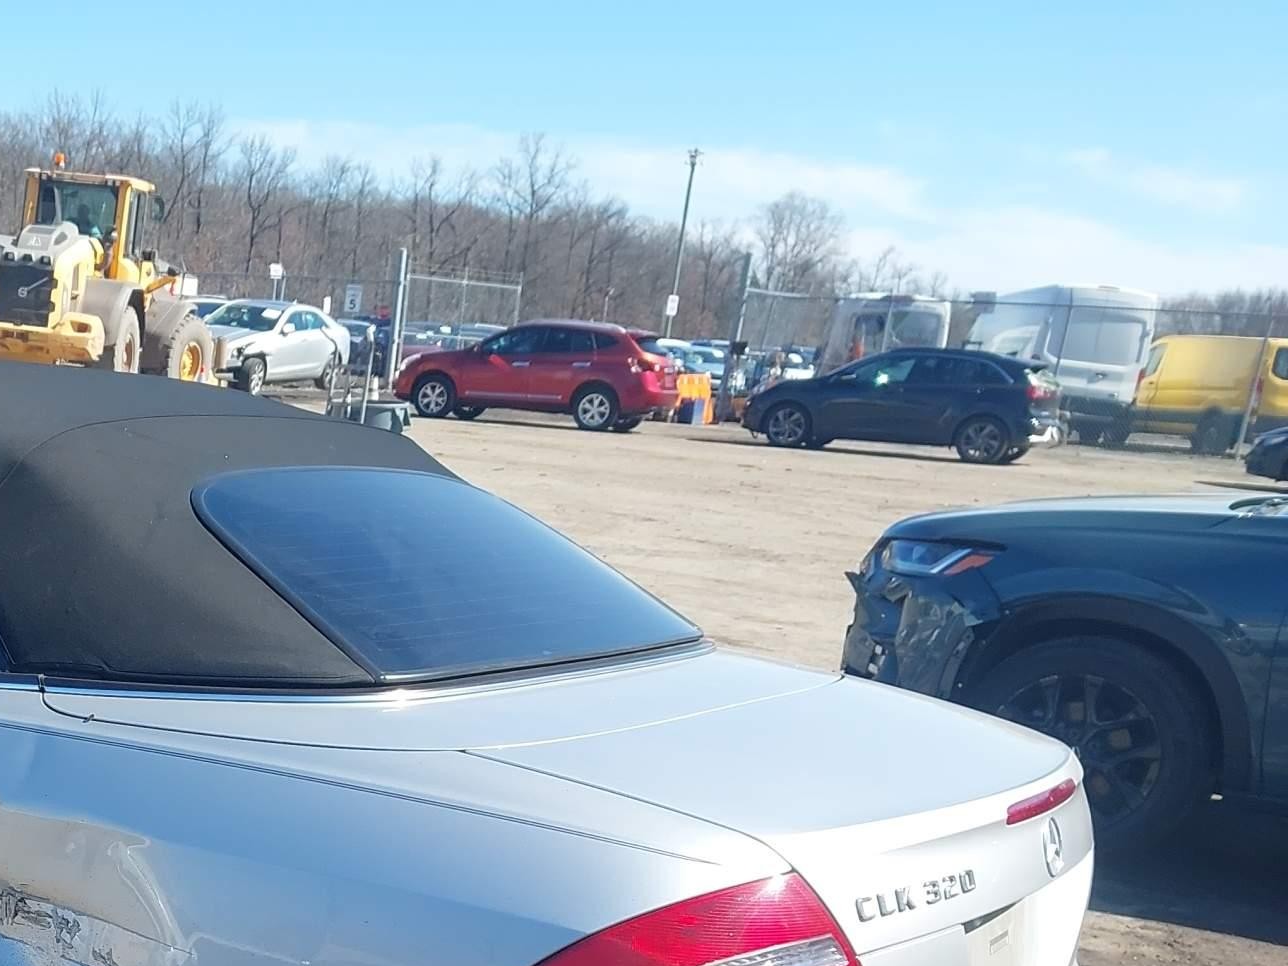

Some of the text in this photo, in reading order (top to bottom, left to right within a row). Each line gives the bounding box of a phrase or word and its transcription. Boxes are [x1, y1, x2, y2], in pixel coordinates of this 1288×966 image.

[348, 298, 357, 310] 5
[855, 869, 977, 923] CLK 320
